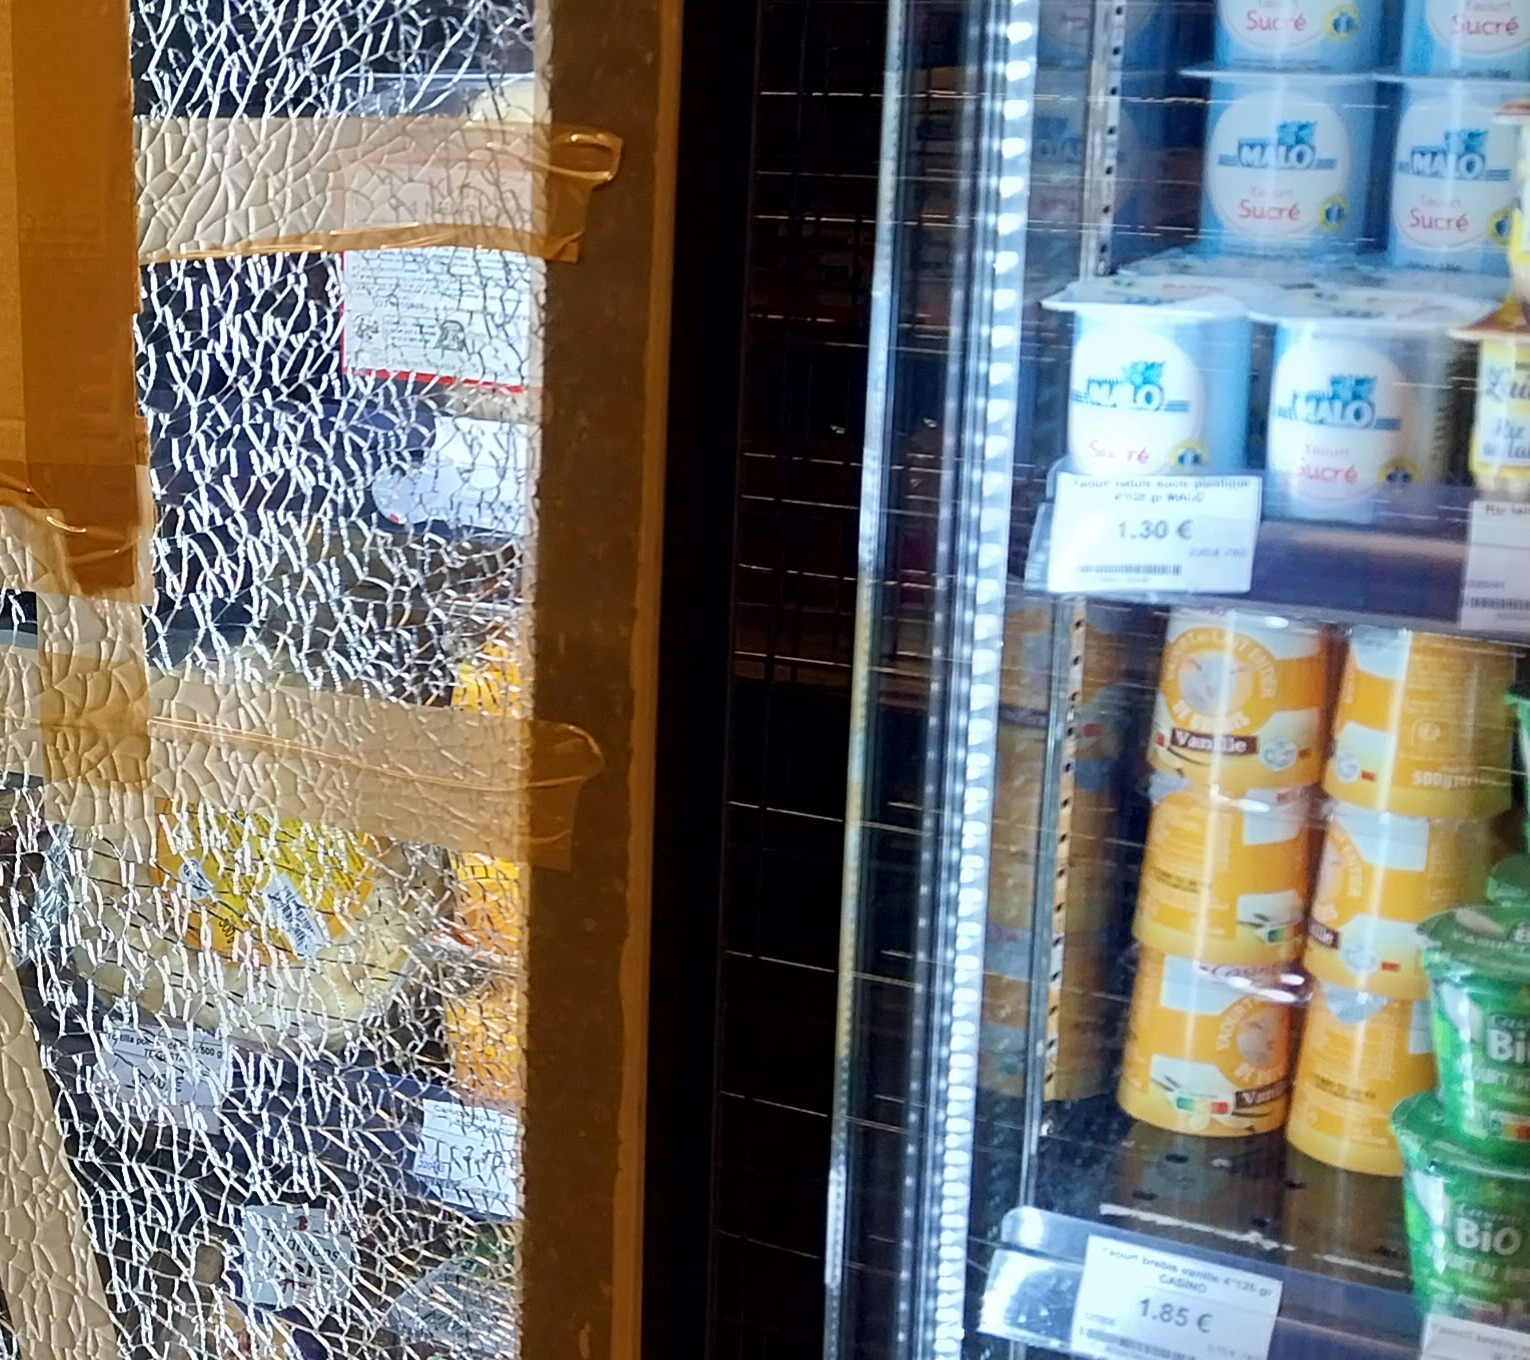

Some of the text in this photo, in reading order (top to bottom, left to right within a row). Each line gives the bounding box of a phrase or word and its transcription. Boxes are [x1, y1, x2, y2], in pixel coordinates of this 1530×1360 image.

[1245, 9, 1308, 32] Sucré
[1237, 142, 1317, 170] MALO
[1238, 199, 1302, 223] Sucré
[1409, 207, 1470, 232] Sucré
[1118, 519, 1195, 541] 1.30 €
[1139, 1297, 1190, 1328] 1.85
[1196, 1311, 1215, 1334] €
